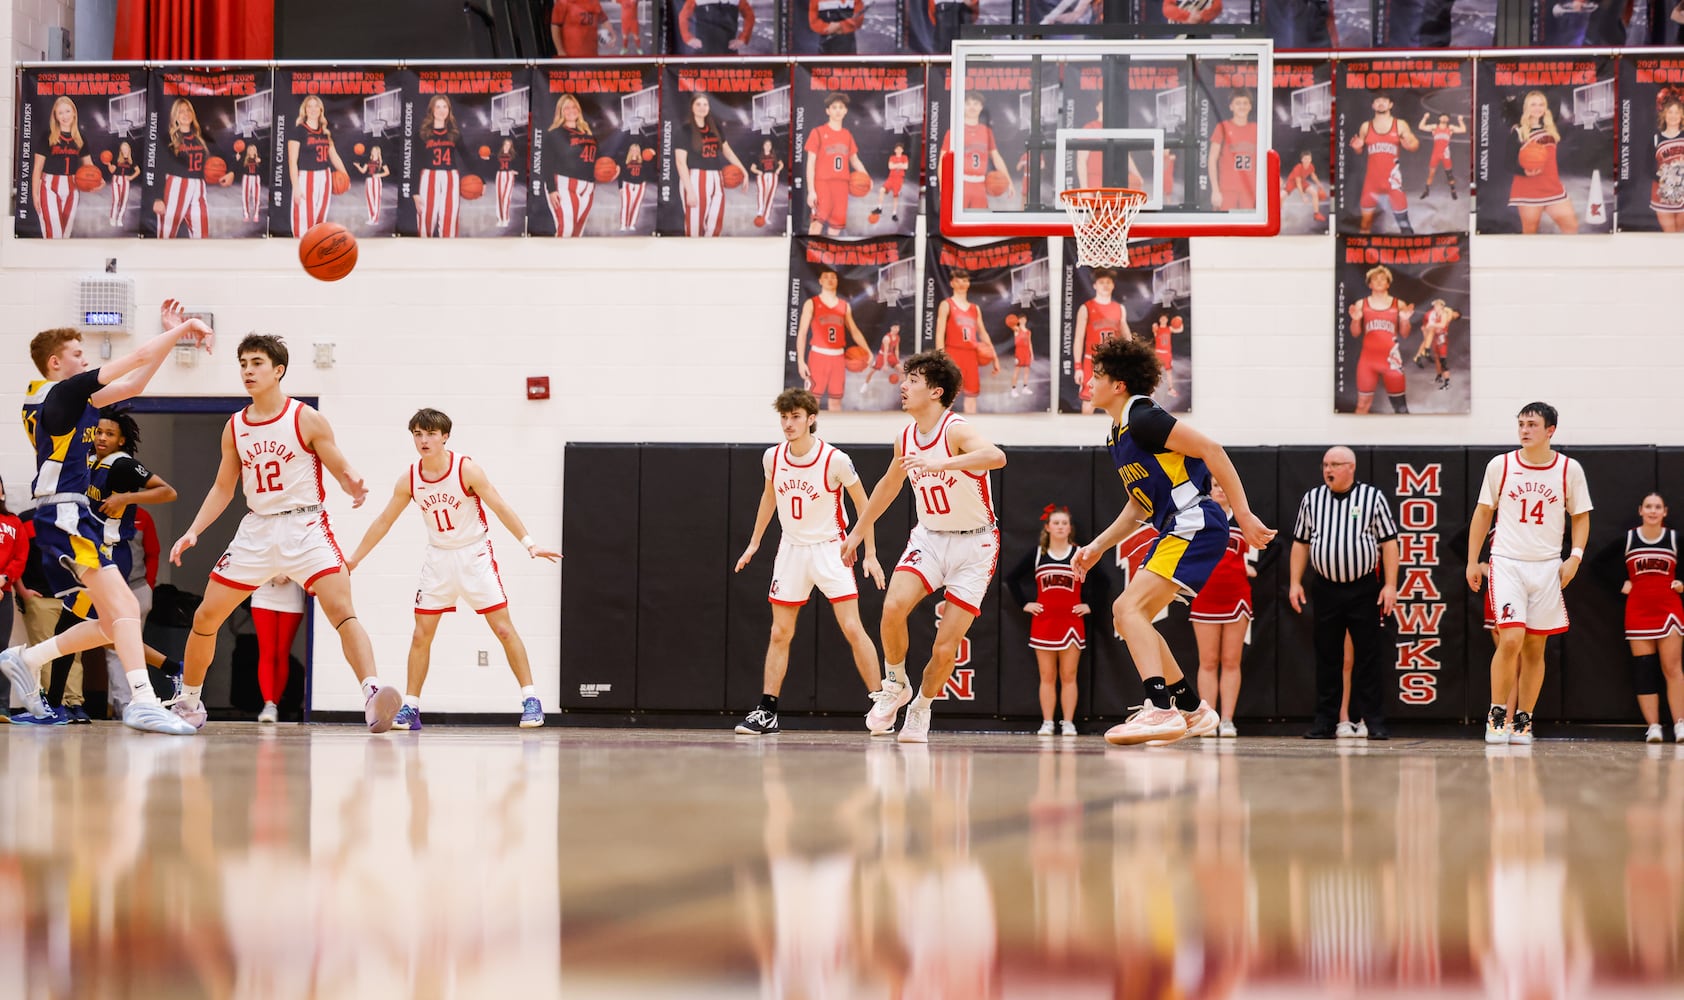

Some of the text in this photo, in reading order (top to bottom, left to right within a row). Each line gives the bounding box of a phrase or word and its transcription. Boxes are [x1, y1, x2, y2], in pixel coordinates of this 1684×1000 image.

[292, 72, 384, 80] 2025 MADISON 2026
[420, 71, 512, 80] 2025 MADISON 2026
[550, 70, 641, 79] 2025 MADISON 2026
[679, 70, 773, 78] 2025 MADISON 2026
[811, 68, 907, 76] 2025 MADISON 2026
[1348, 60, 1460, 72] 2025 MADISON 2026
[1496, 62, 1596, 71] 2025 MADISON 2026
[38, 73, 130, 82] 2025 MADISON 2026
[164, 74, 254, 84] 2025 MADISON 2026
[292, 80, 386, 94] MOHAWKS
[419, 80, 512, 94] MOHAWKS
[550, 79, 642, 93] MOHAWKS
[678, 78, 774, 92] MOHAWKS
[810, 76, 908, 91] MOHAWKS
[944, 76, 1032, 90] OHAWK
[1214, 73, 1314, 88] MOHWKS
[1346, 72, 1462, 89] MOHAWKS
[1495, 70, 1598, 86] MOHAWKS
[37, 82, 131, 96] MOHAWKS
[164, 82, 256, 96] MOHAWKS
[796, 107, 804, 130] WING
[930, 101, 939, 141] JOHNSON
[276, 115, 285, 162] CARPENTER
[534, 128, 542, 149] JETT
[664, 120, 672, 156] HARDEN
[795, 133, 803, 162] MASON
[1480, 104, 1489, 181] ALAINA LYNINGER
[148, 143, 156, 168] EMMA
[404, 140, 412, 178] MADALYN
[432, 148, 452, 166] 34
[534, 151, 542, 174] ANNA
[929, 143, 938, 170] GAVIN
[1621, 146, 1630, 180] HEAVYN
[275, 165, 283, 186] LIVIA
[662, 158, 670, 180] MADI
[20, 181, 28, 204] MARE
[20, 210, 27, 219] #1
[1372, 236, 1430, 247] MADISON
[807, 248, 899, 265] MOHAWKS
[1346, 247, 1460, 264] MOHAWKS
[792, 278, 800, 306] SMITH
[1064, 264, 1074, 320] SHORTRIDGE
[925, 278, 935, 340] LOGAN BUDDO
[790, 308, 798, 336] DYLON
[1064, 322, 1072, 356] JAYDEN
[243, 440, 296, 470] MADISON
[254, 460, 284, 494] 12
[778, 480, 820, 501] MADISON
[920, 485, 950, 514] 10
[1508, 482, 1558, 504] MADISON
[420, 493, 462, 514] MADISON
[792, 496, 802, 520] 0
[1520, 498, 1544, 524] 14
[432, 508, 455, 532] 11
[1393, 463, 1446, 704] MOHAWKS
